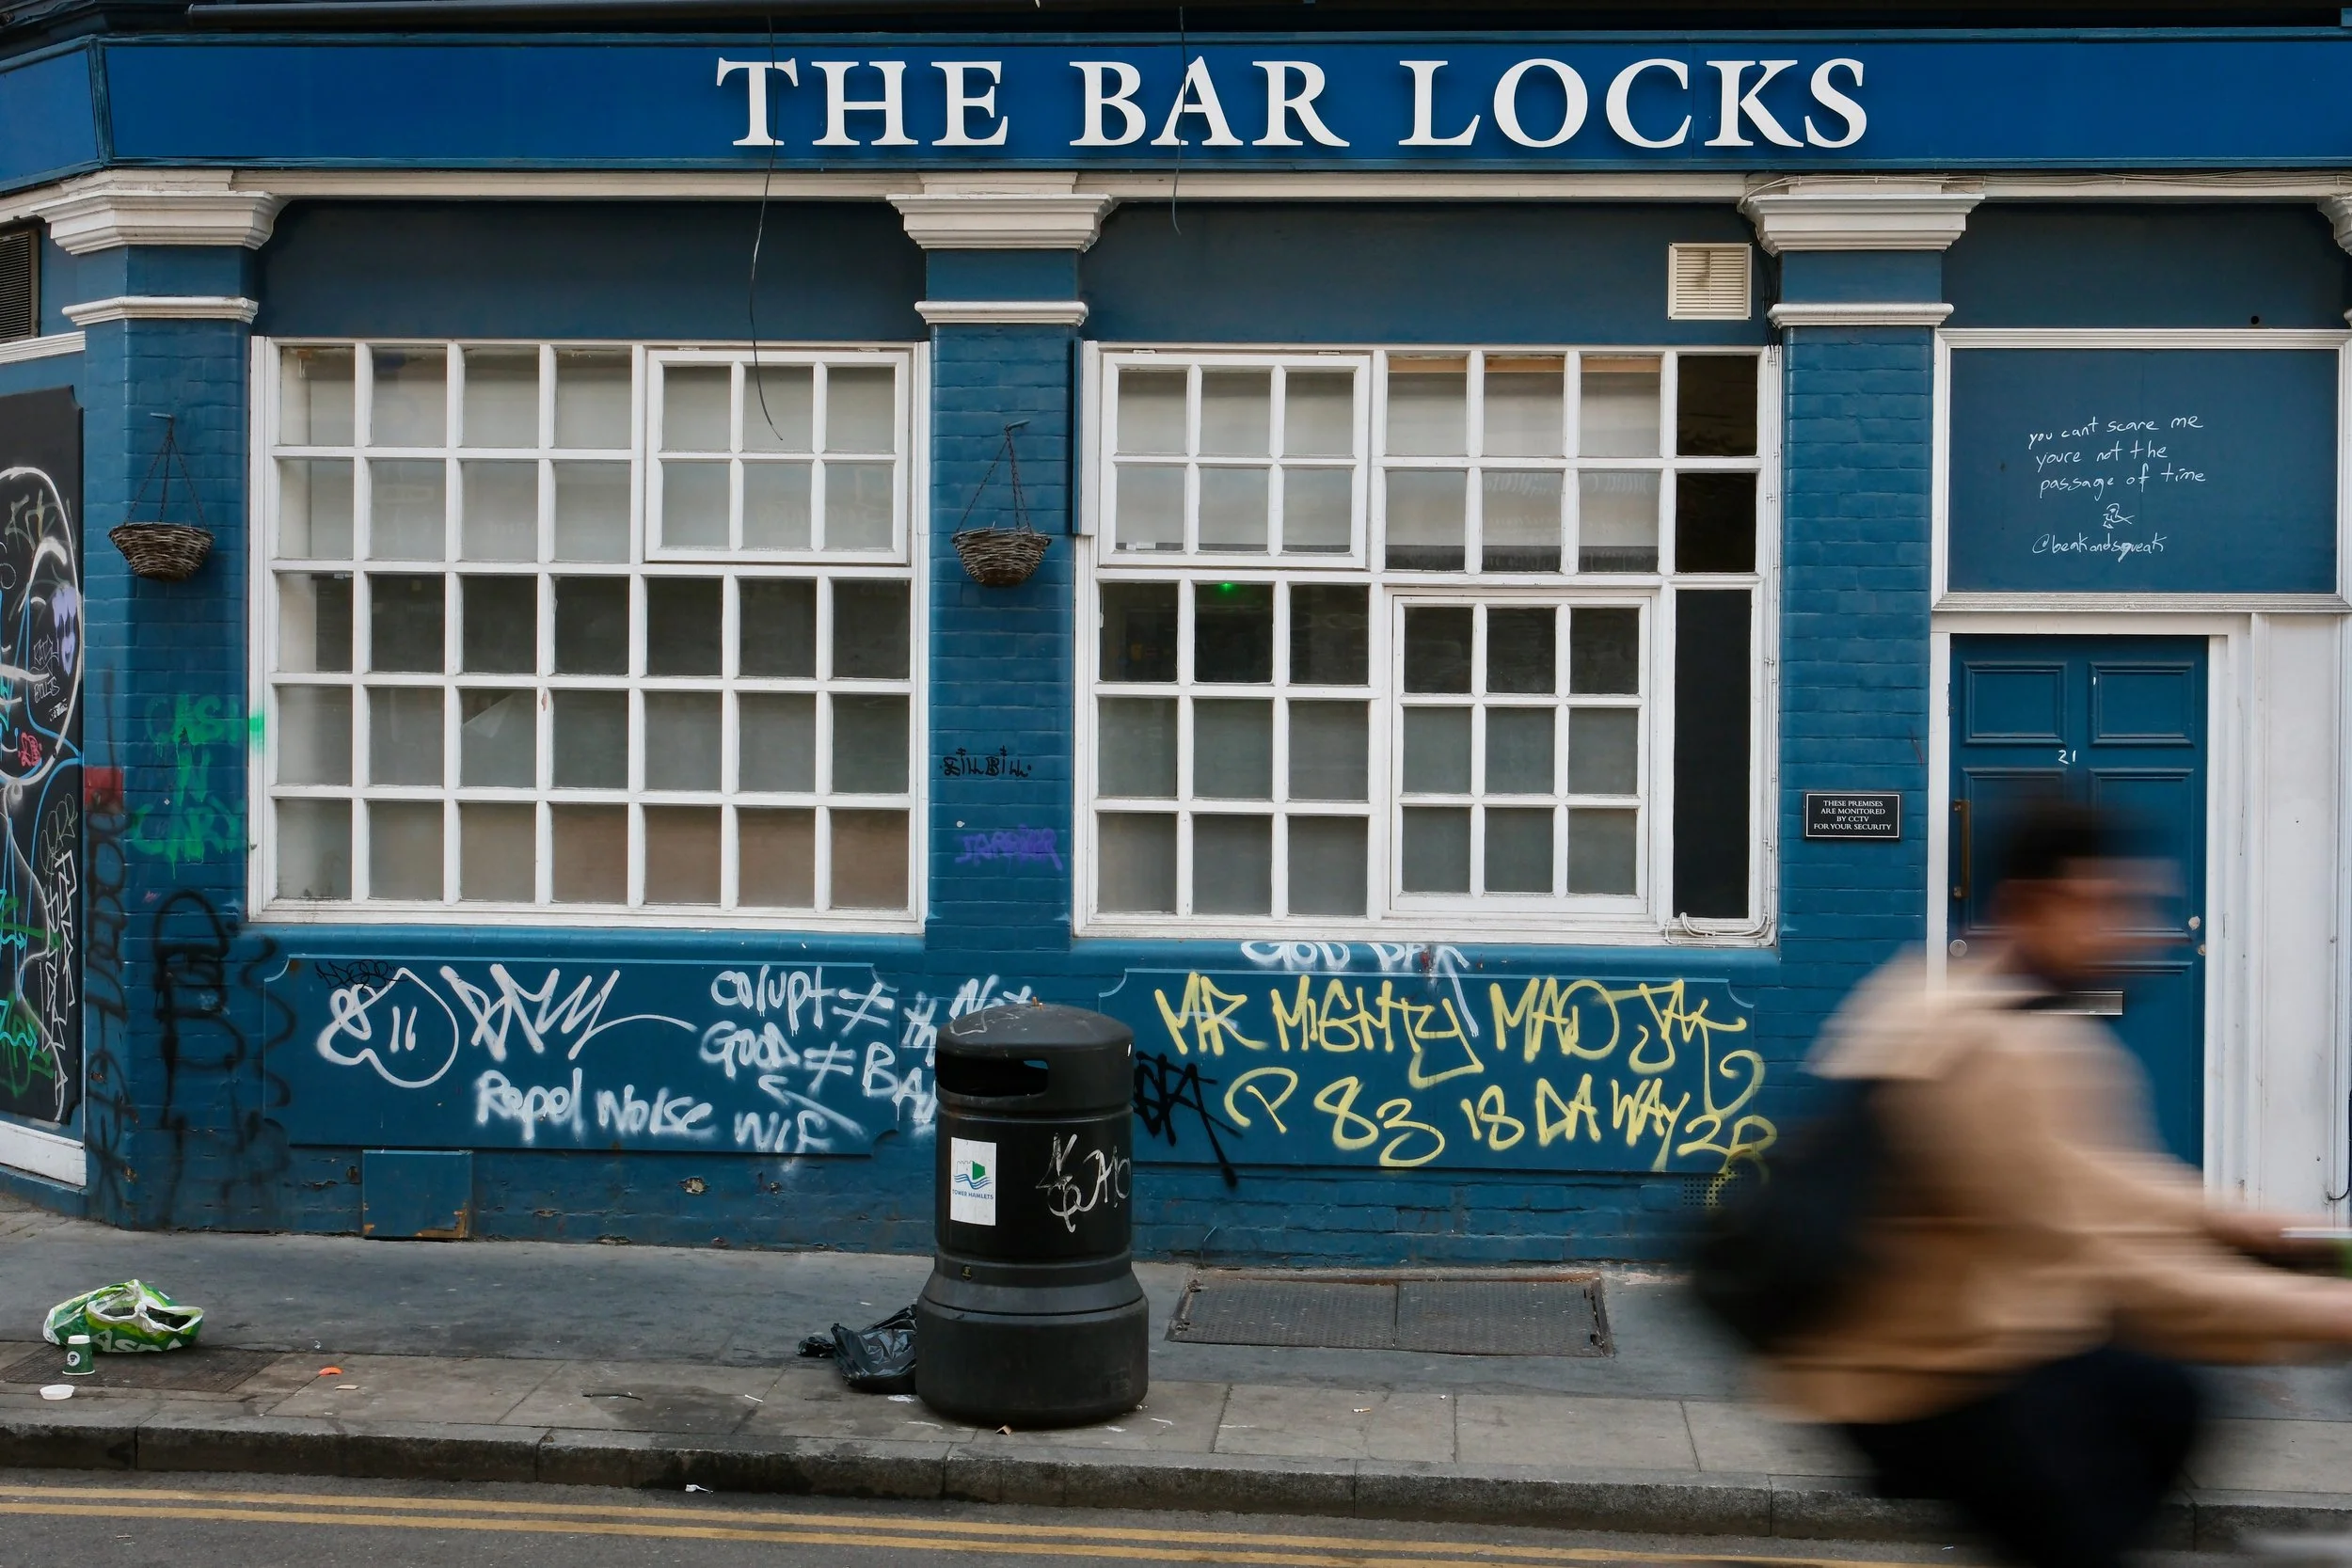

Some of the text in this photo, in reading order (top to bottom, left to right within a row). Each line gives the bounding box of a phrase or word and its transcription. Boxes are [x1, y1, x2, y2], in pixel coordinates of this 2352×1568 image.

[715, 55, 1867, 150] THE BAR LOCKS
[2028, 415, 2204, 451] you cant scare me
[2036, 439, 2169, 473] youre not the
[2040, 463, 2206, 501] passage of time
[2058, 749, 2076, 765] 21
